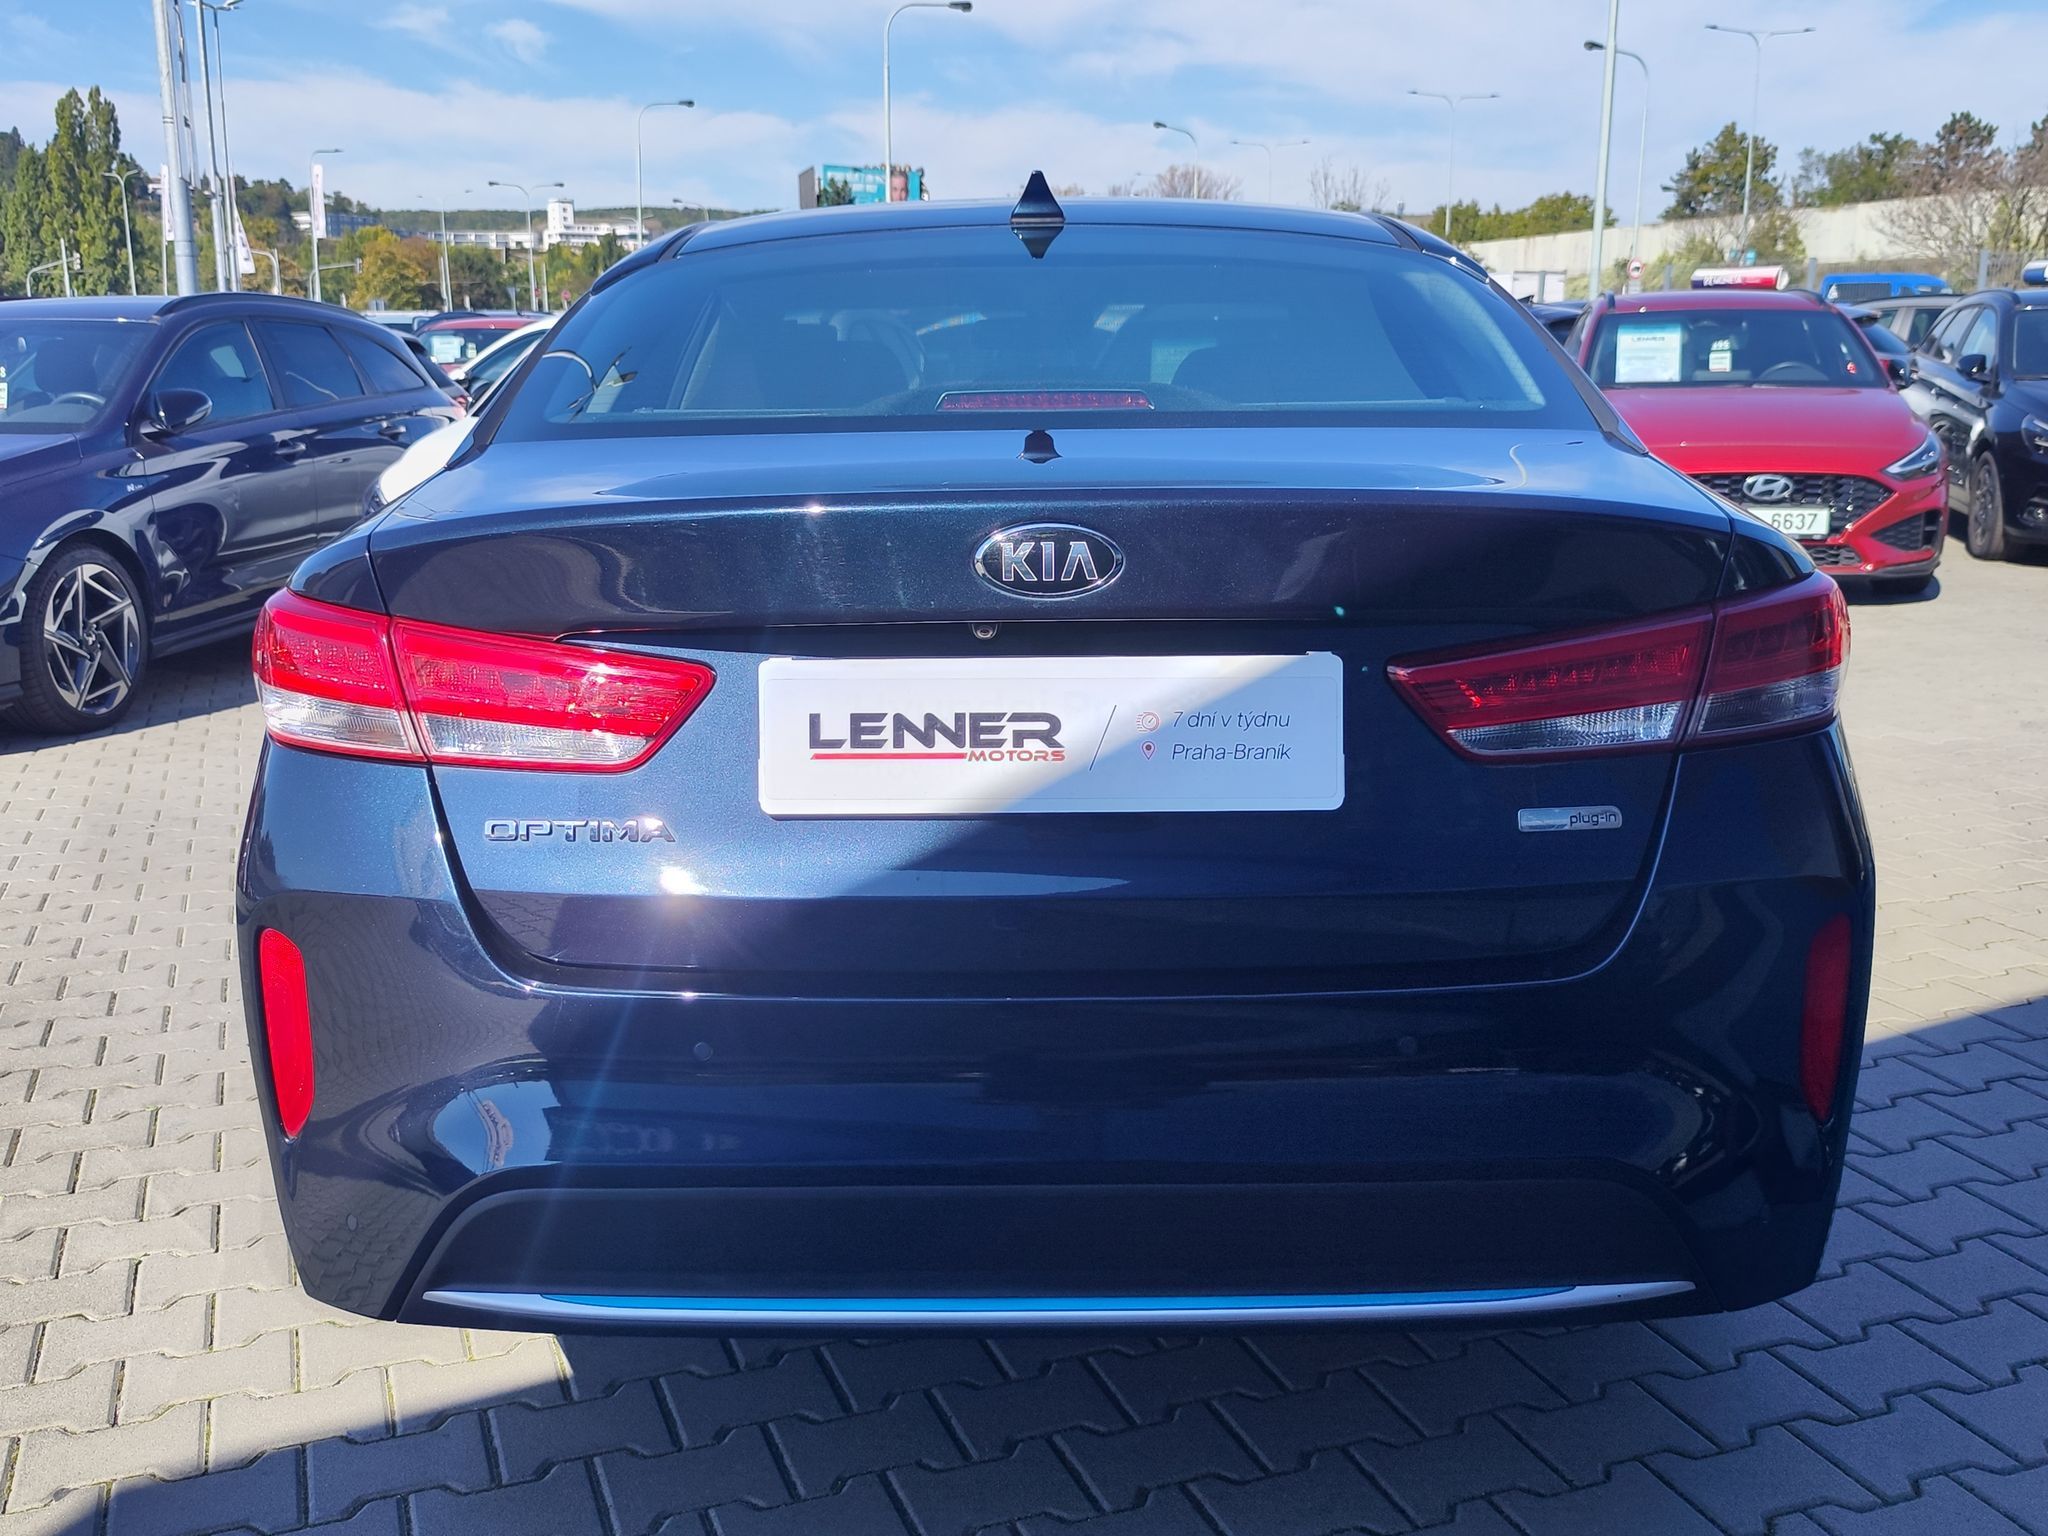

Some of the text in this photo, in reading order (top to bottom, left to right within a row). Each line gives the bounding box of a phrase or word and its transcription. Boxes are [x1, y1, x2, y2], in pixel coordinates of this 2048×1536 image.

[1771, 513, 1817, 530] 6637
[1000, 541, 1098, 581] KIA
[809, 712, 1065, 749] LENNER
[1173, 711, 1290, 732] 7 dní v týdnu
[968, 750, 1066, 762] MOTORS
[1171, 743, 1292, 761] Praha-Braník
[1569, 812, 1617, 827] plug-in
[484, 819, 676, 843] OPTIMA
